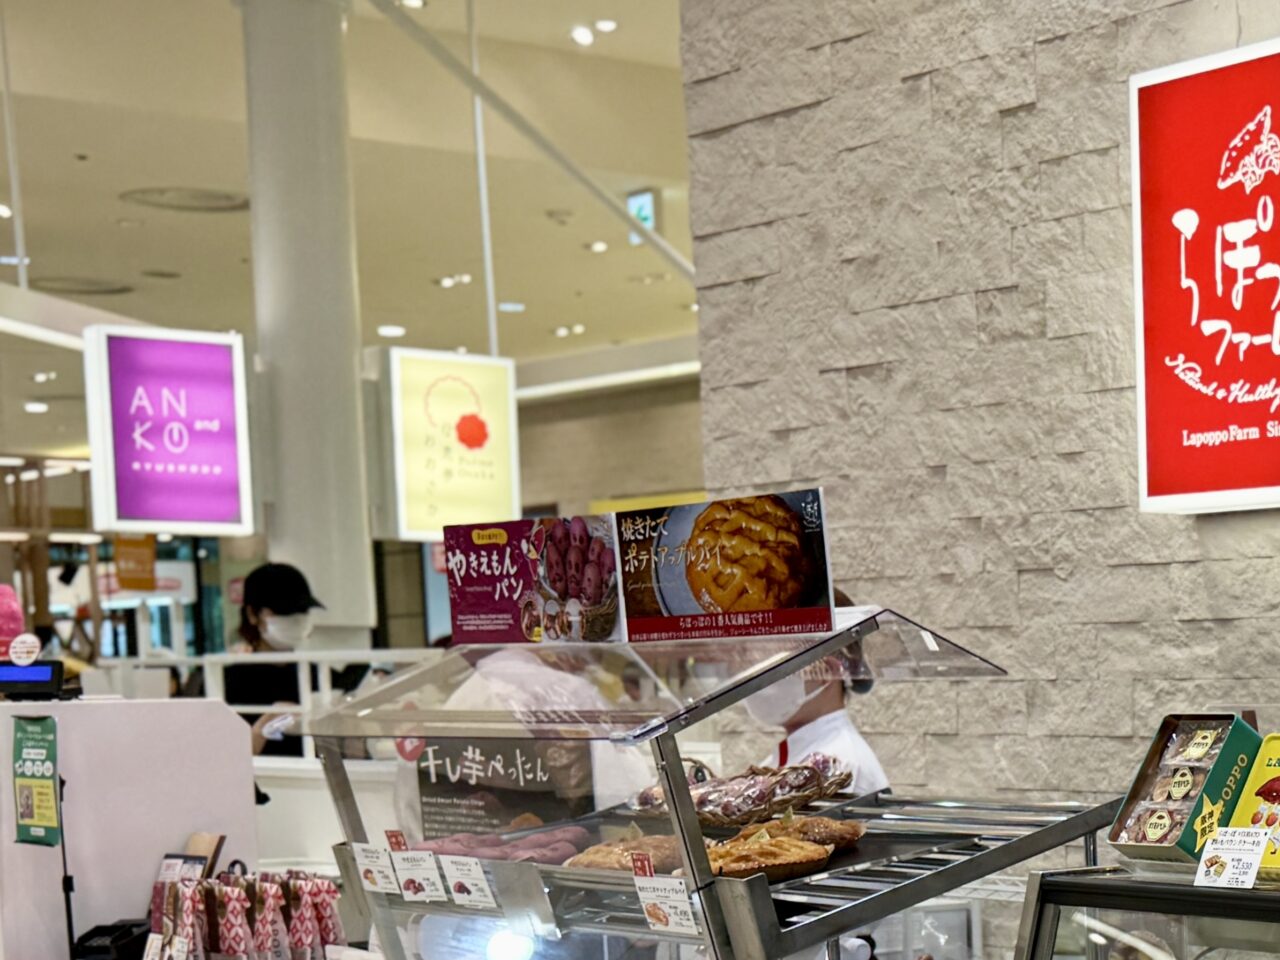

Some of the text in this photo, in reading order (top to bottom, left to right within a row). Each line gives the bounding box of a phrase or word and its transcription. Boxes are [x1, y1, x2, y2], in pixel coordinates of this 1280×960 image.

[129, 386, 187, 418] AN
[1182, 428, 1228, 447] Lapoppo
[1230, 425, 1259, 441] Farm
[621, 514, 669, 541] 焼きたて
[447, 546, 518, 587] やきえもん
[624, 540, 722, 573] ポテトアップルパイ
[494, 576, 523, 601] パン
[420, 745, 550, 786] 干し芋ぺったん
[1221, 753, 1248, 801] OPPO
